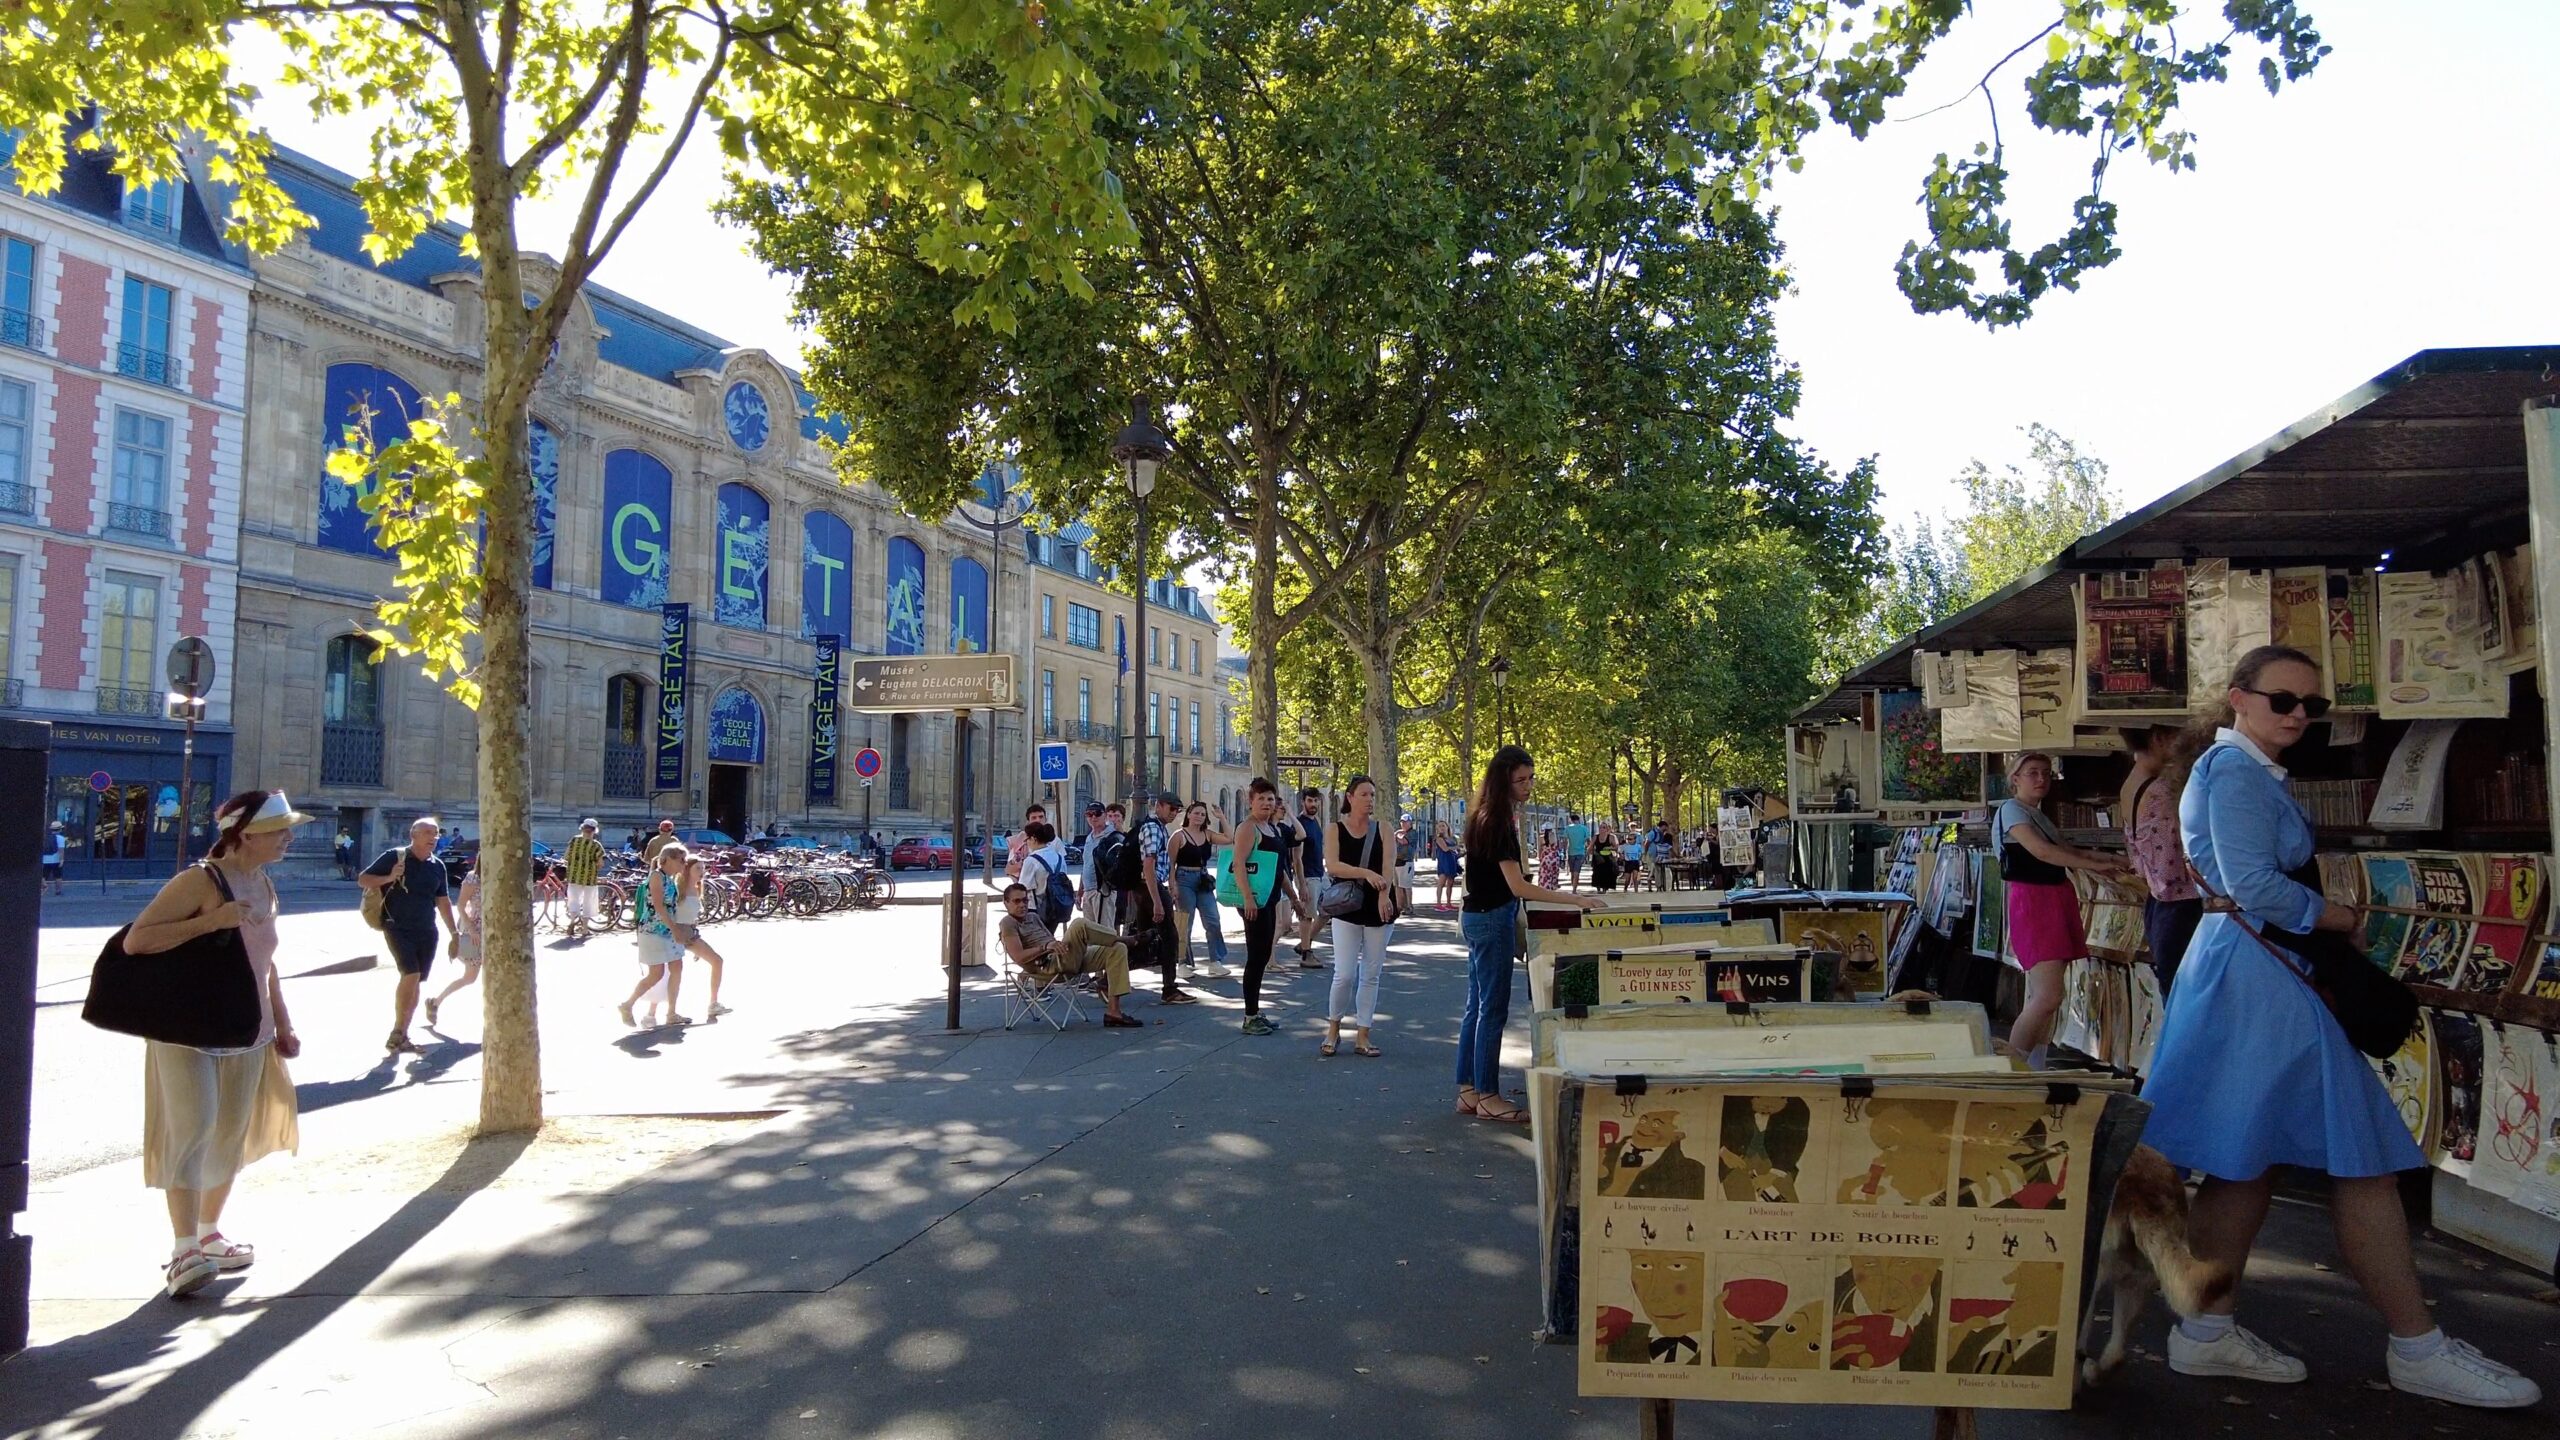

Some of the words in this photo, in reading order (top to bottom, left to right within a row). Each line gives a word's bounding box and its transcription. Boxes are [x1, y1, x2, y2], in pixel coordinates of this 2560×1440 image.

[880, 665, 914, 676] Musée
[658, 623, 684, 750] VÉGÉTAL
[880, 679, 918, 691] Eugène
[922, 677, 984, 688] DELACROIX
[891, 692, 907, 700] Rue
[911, 691, 921, 700] de
[924, 690, 978, 700] Furstemberg
[812, 652, 836, 763] VÉGÉTAL
[84, 730, 110, 741] VAN
[116, 733, 160, 745] NOTEN
[726, 728, 738, 738] DE
[738, 729, 748, 739] LA
[2424, 870, 2463, 888] STAR
[2425, 887, 2466, 905] WARS
[1655, 967, 1674, 979] day
[1678, 966, 1693, 977] for
[1745, 974, 1790, 987] VINS
[1620, 984, 1626, 992] a
[1613, 1201, 1623, 1210] Le
[1748, 1207, 1794, 1217] Déboucher
[1723, 1229, 1798, 1242] L'ART
[1810, 1230, 1845, 1243] DE
[1856, 1231, 1939, 1246] BOIRE
[1606, 1368, 1654, 1380] Préparation
[1657, 1371, 1690, 1380] mentale
[1731, 1371, 1757, 1381] Plaisir
[1852, 1375, 1879, 1385] Plaisir
[1881, 1375, 1893, 1385] du
[1957, 1377, 1987, 1388] Plaisir
